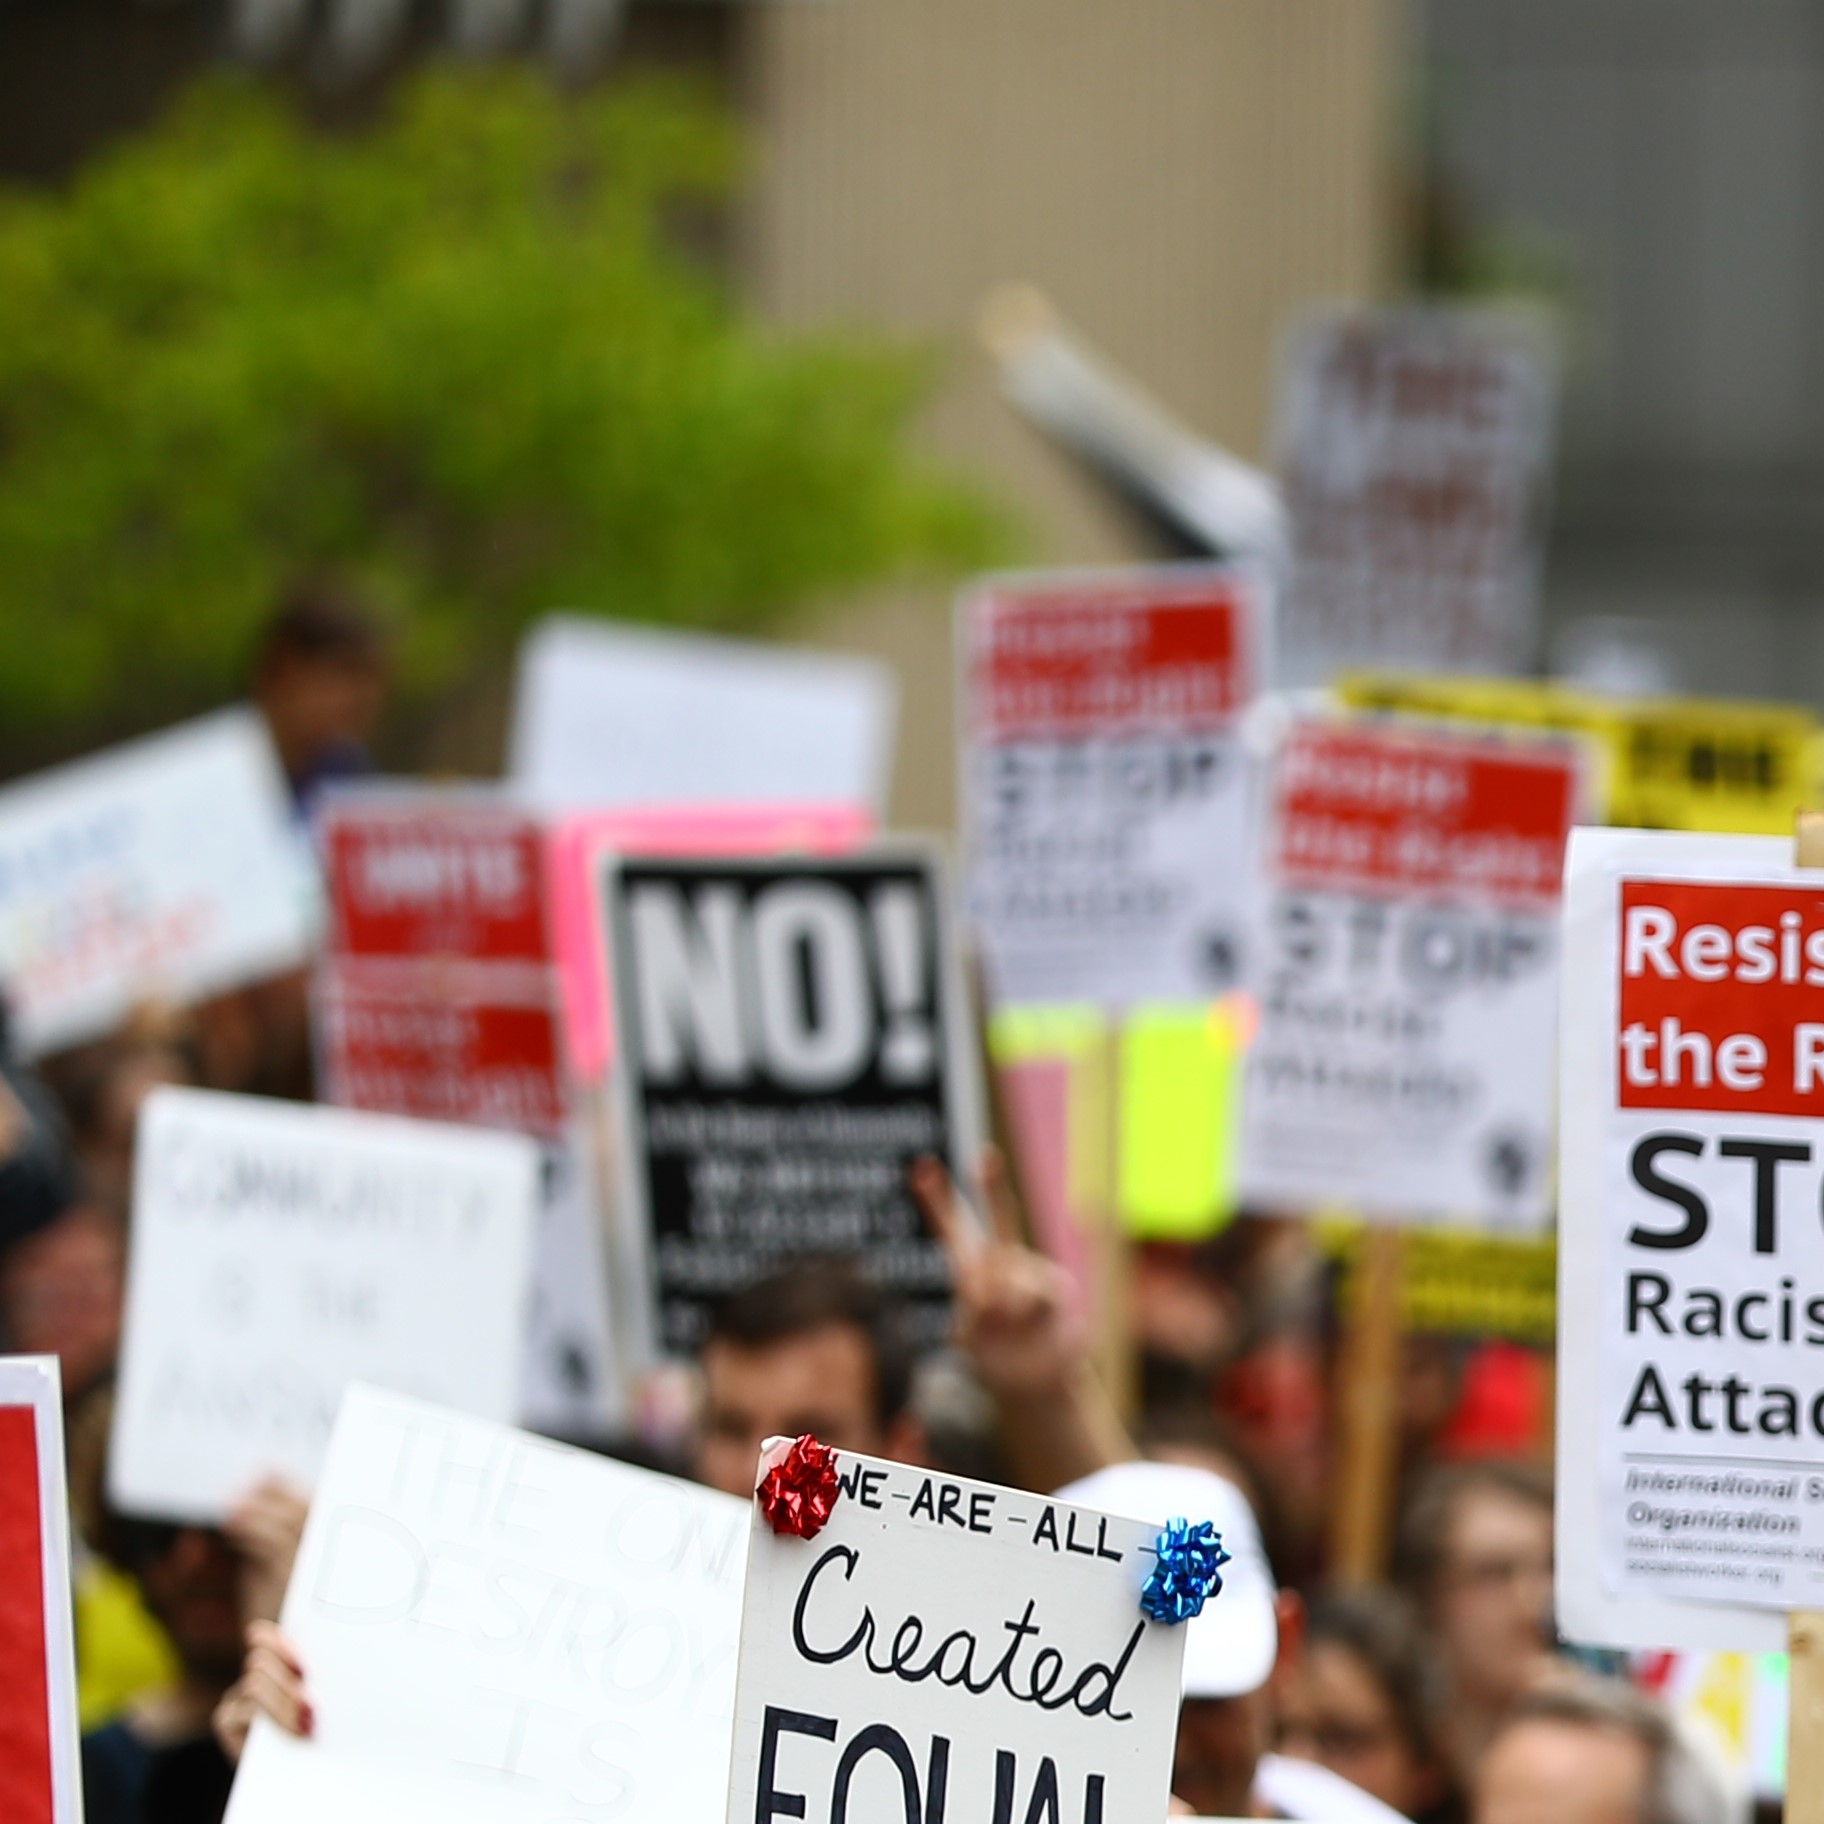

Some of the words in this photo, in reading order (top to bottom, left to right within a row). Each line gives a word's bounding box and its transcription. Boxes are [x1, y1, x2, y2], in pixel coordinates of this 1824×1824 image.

[629, 877, 934, 1092] NO!
[1622, 1018, 1768, 1090] the
[1624, 1467, 1798, 1499] International
[1626, 1501, 1802, 1534] Organization
[793, 1544, 1146, 1723] Created
